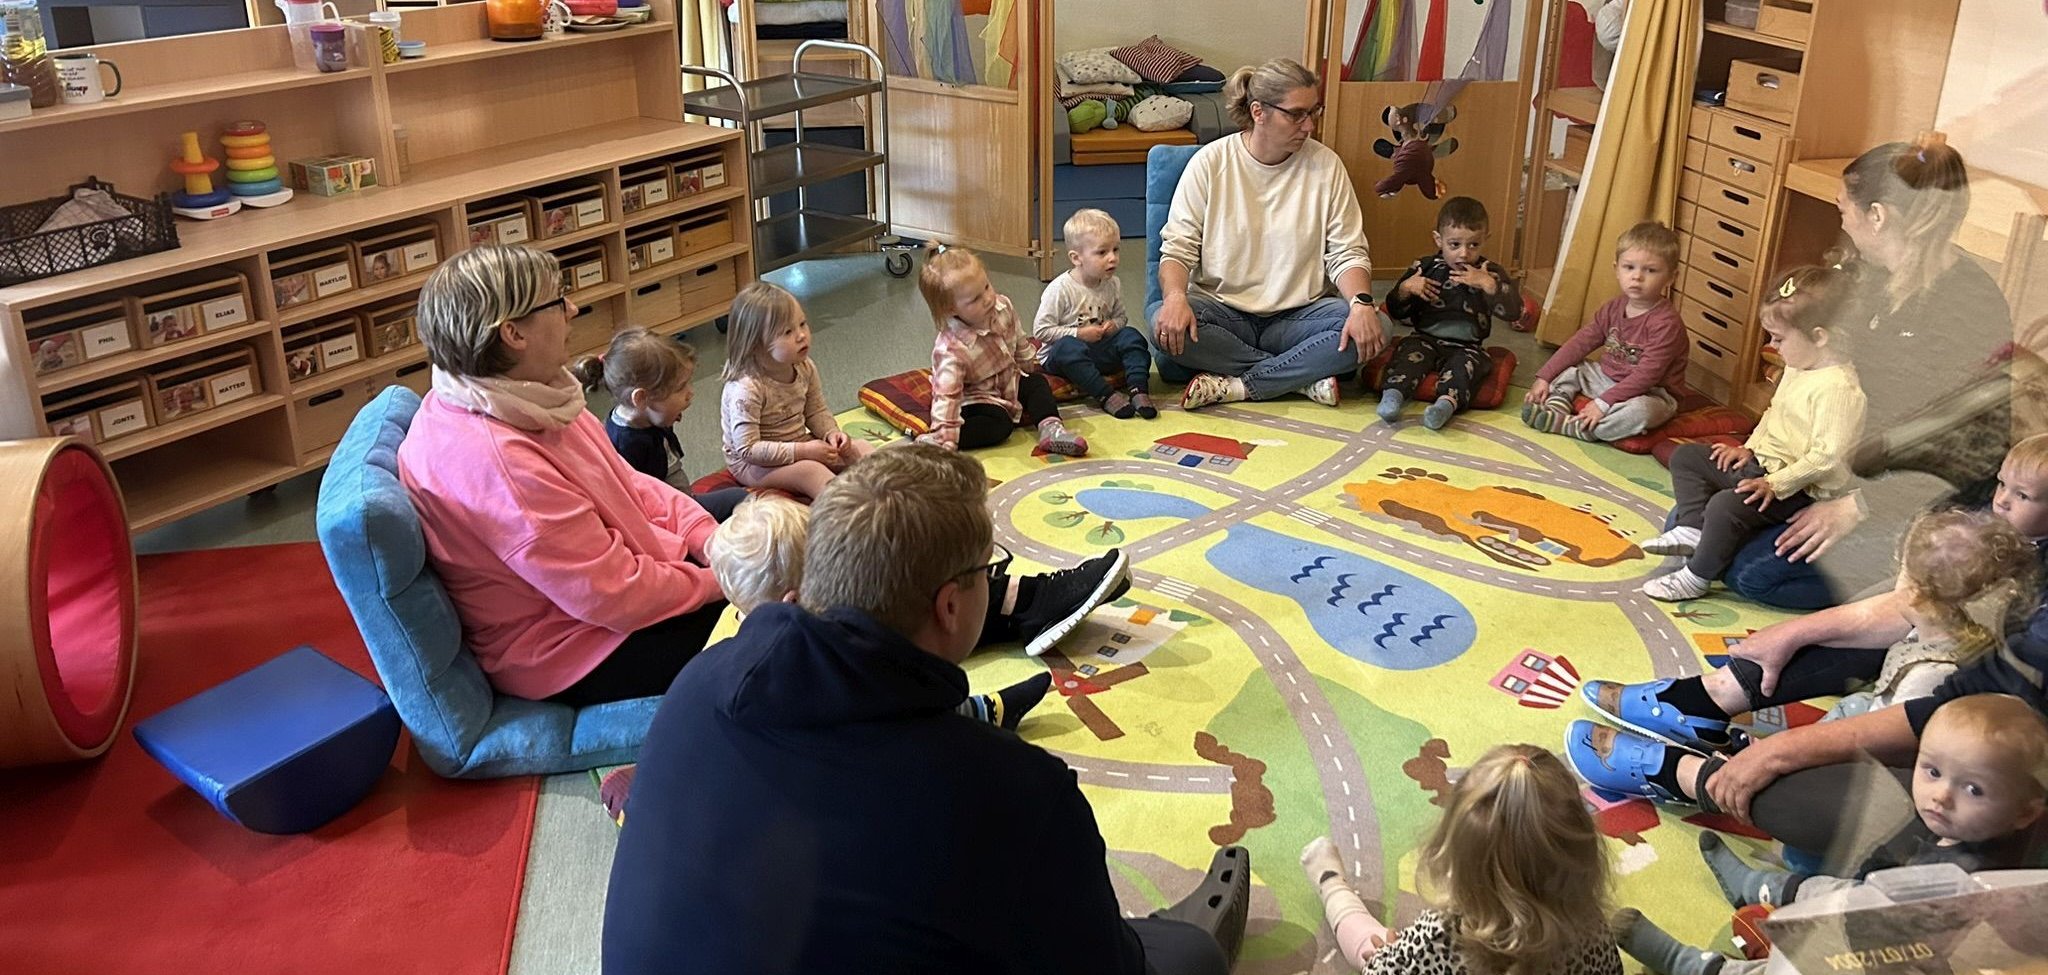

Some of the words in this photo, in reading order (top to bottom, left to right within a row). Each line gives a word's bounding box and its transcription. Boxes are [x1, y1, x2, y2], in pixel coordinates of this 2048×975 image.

[319, 274, 347, 287] MARYLOU
[215, 309, 235, 319] ELIAS
[98, 336, 116, 345] PHIL
[218, 381, 246, 394] MATTEO
